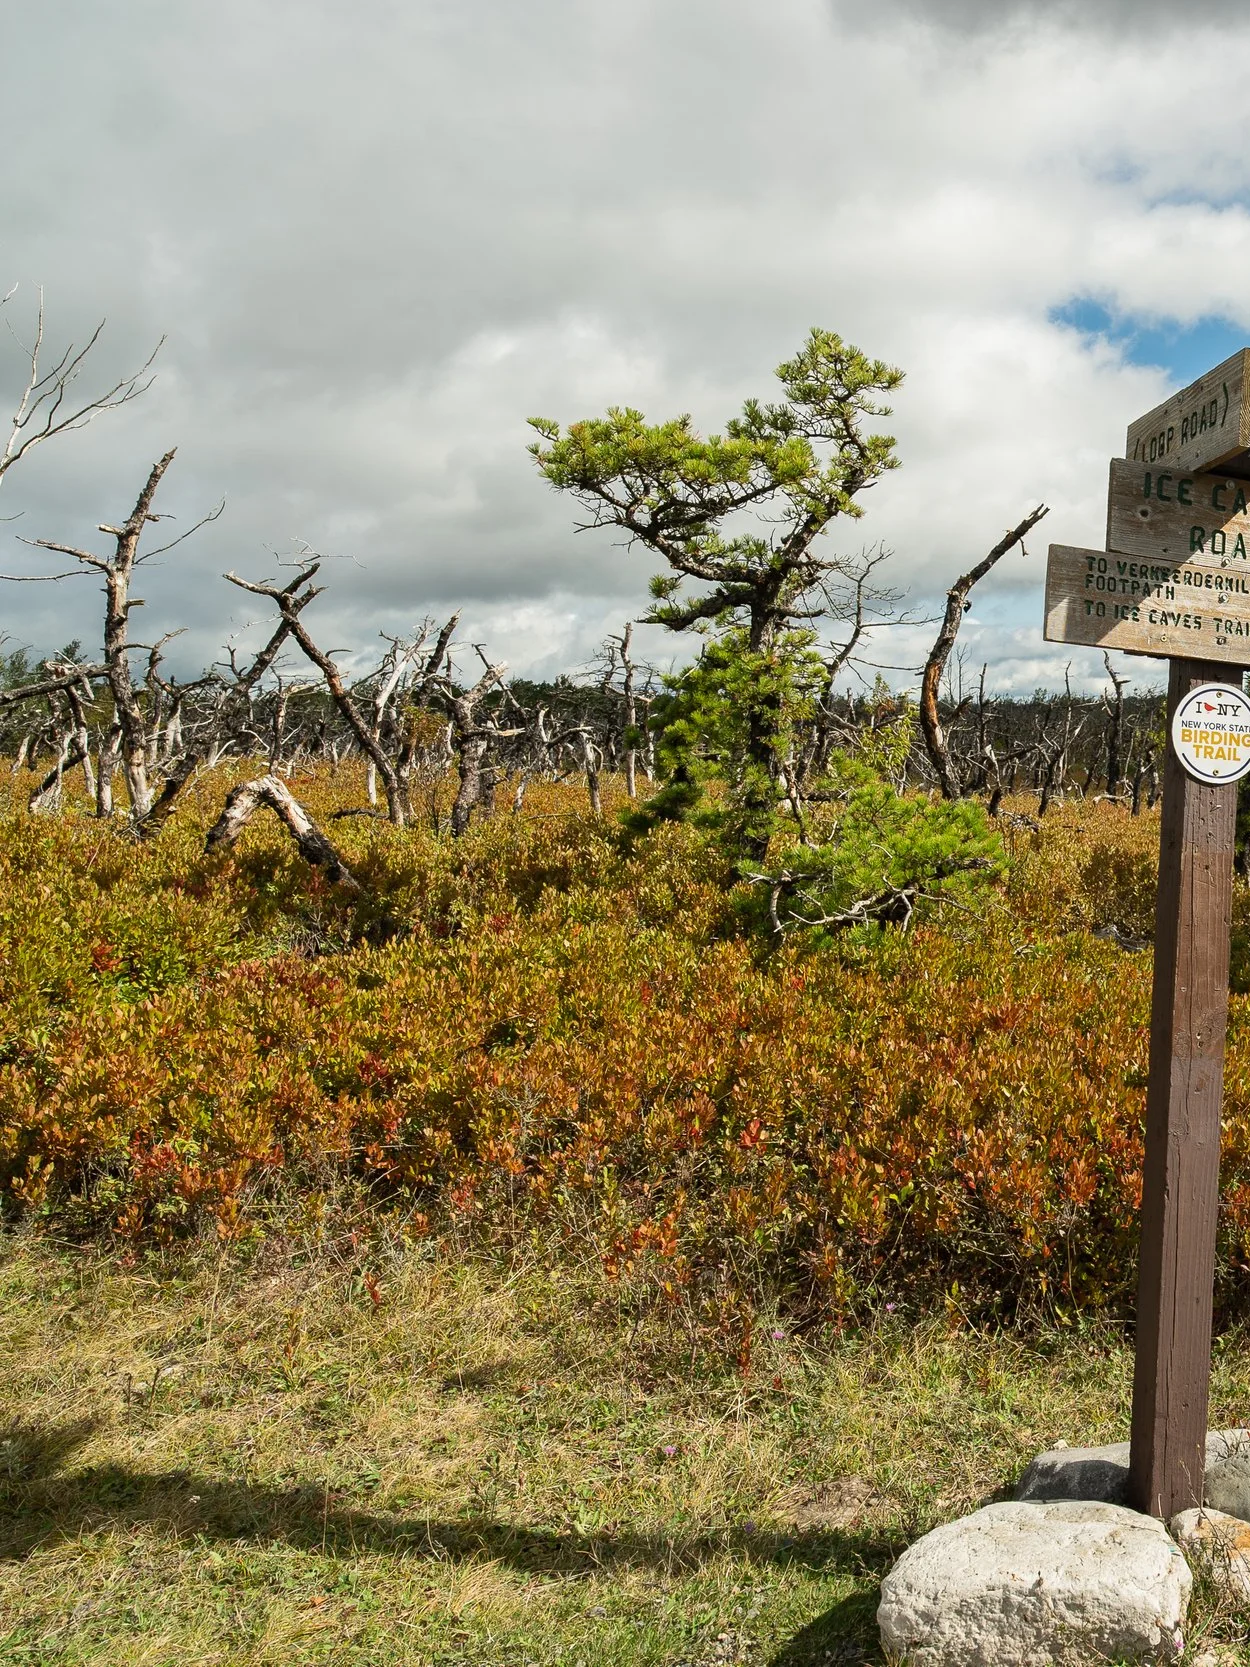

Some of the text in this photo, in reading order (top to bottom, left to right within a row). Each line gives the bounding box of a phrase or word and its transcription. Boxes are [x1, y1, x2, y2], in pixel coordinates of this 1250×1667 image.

[1142, 400, 1218, 463] LOOP ROAD
[1143, 471, 1194, 506] ICE
[1086, 556, 1107, 574] TO
[1085, 574, 1175, 600] FOOTPATH
[1083, 600, 1106, 617] TO
[1114, 605, 1140, 622] ICE
[1149, 609, 1202, 630] CAVES
[1217, 704, 1241, 716] NY
[1181, 720, 1201, 729] NEW
[1204, 722, 1227, 730] YORK
[1193, 745, 1241, 761] TRAIL
